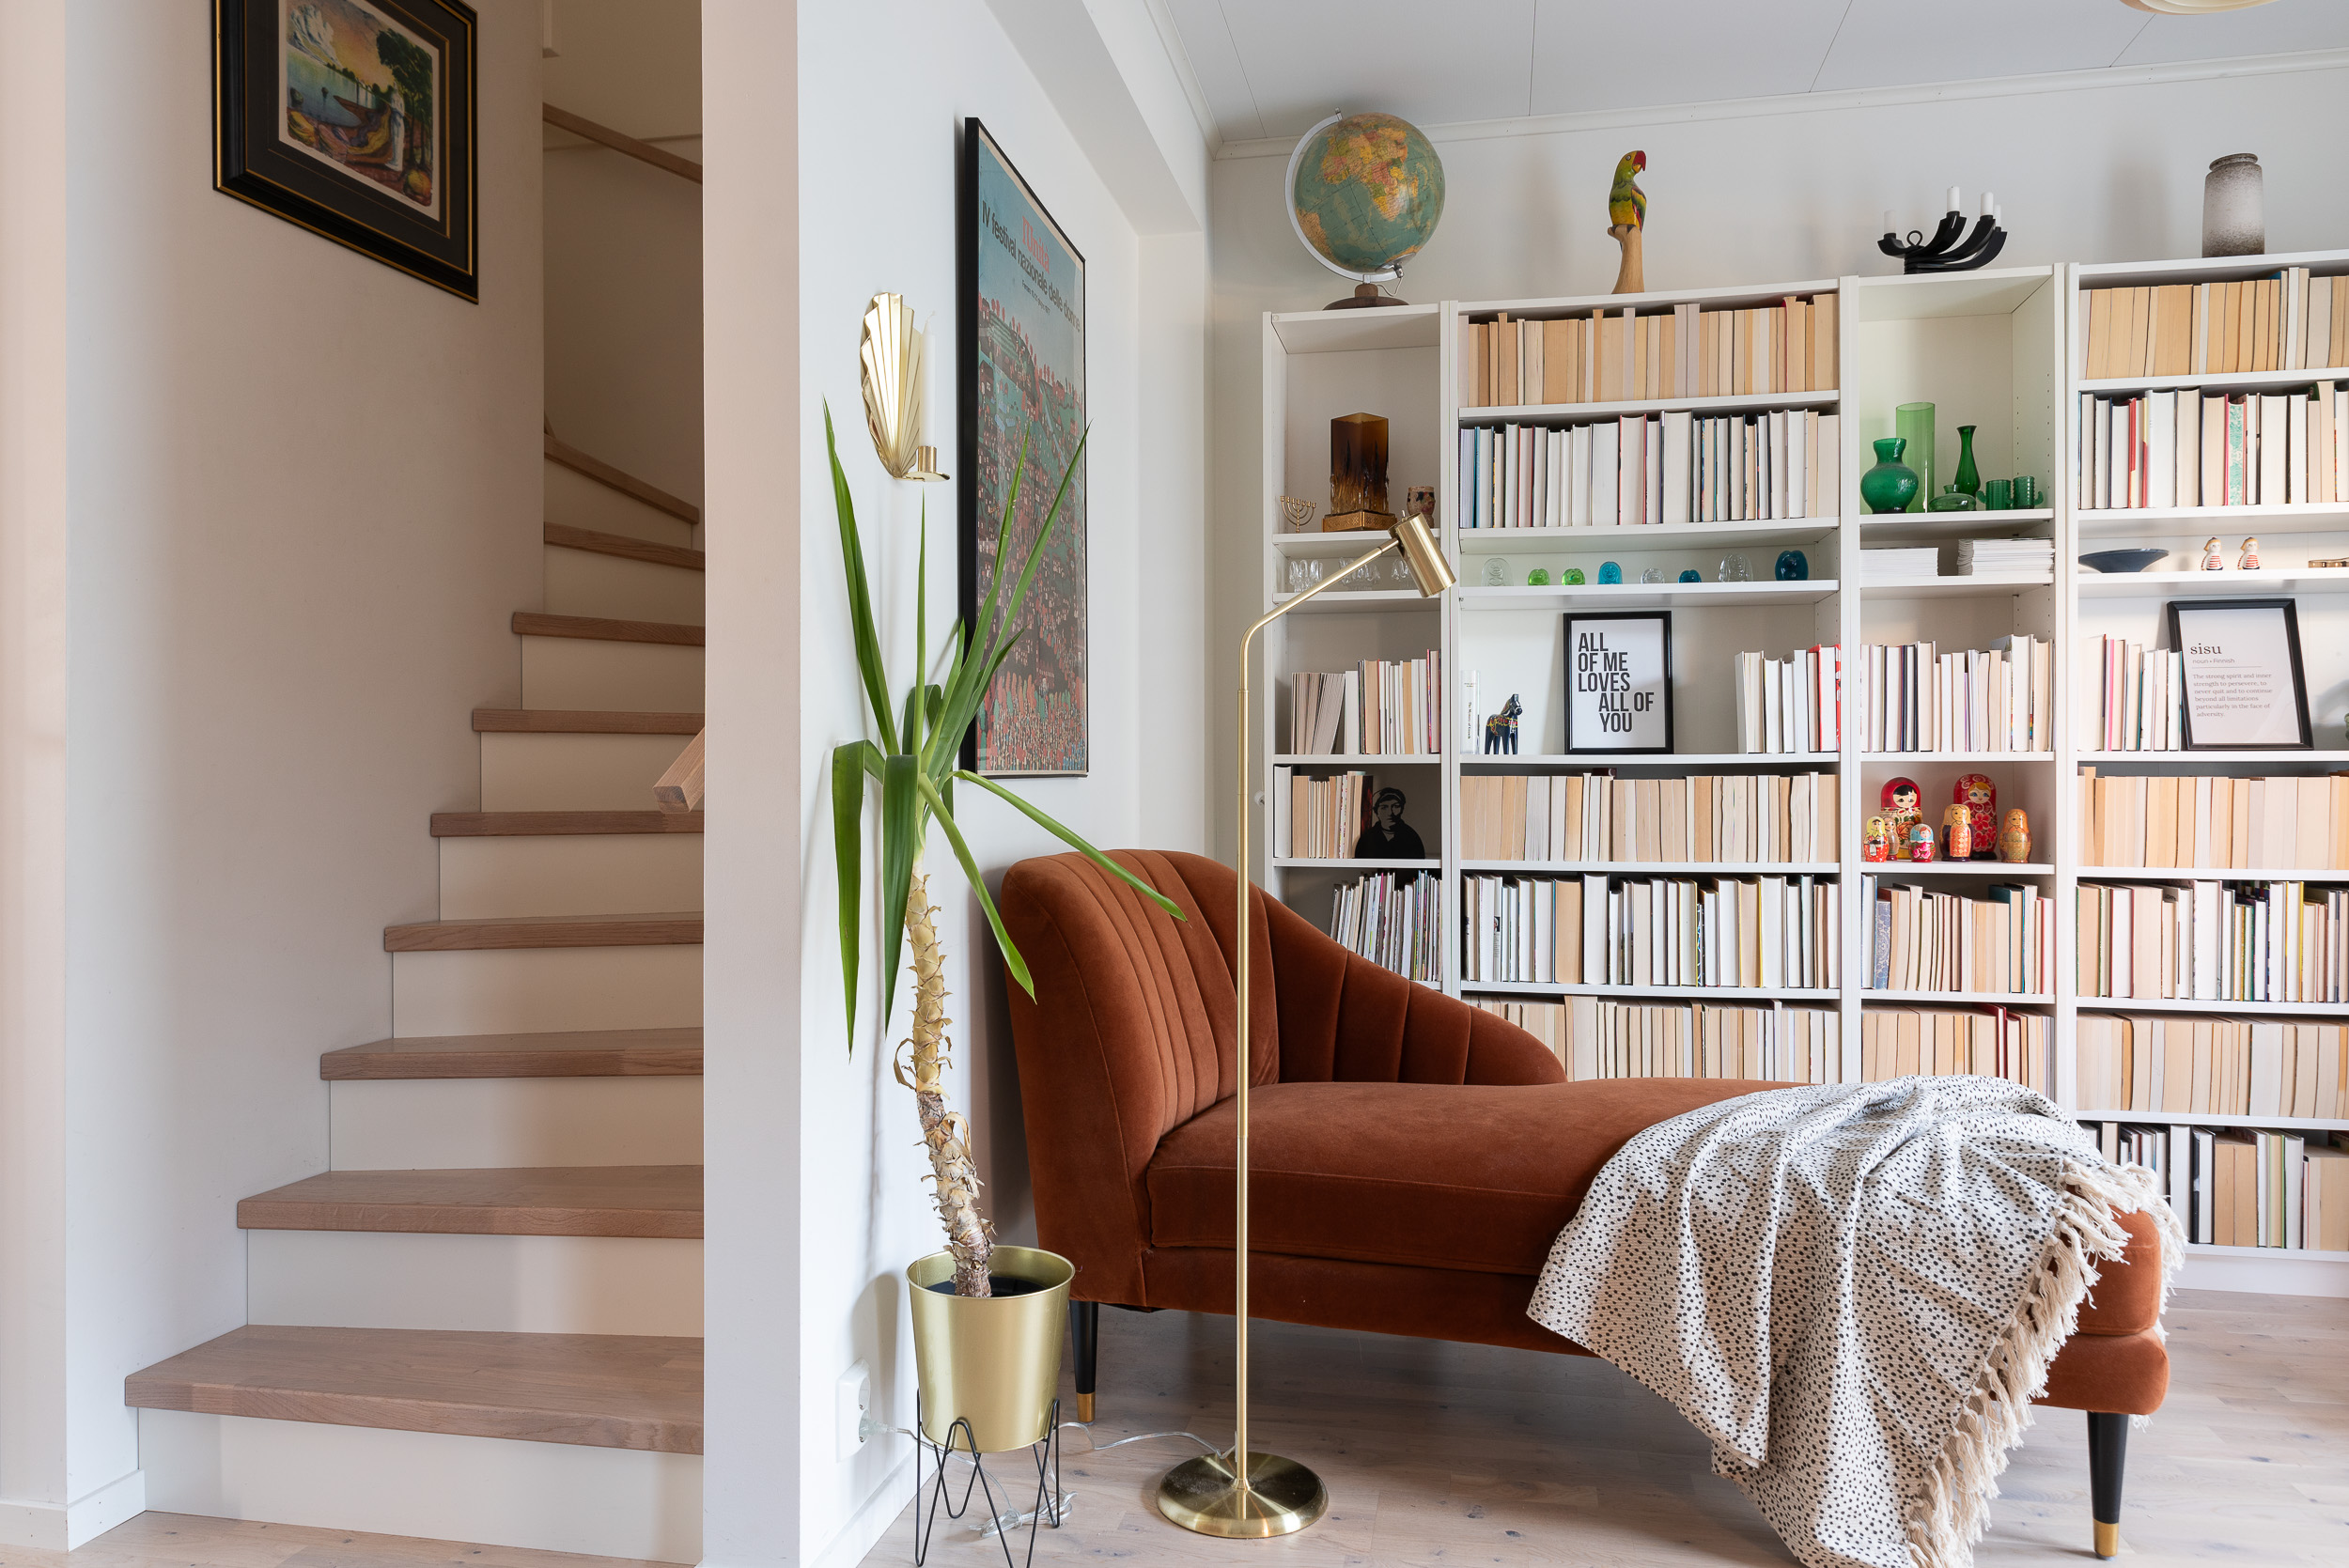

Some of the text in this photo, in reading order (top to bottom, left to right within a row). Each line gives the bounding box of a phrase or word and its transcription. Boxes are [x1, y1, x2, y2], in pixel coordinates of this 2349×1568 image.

[982, 199, 990, 228] IV
[991, 212, 1017, 260] festival
[1018, 248, 1049, 295] nazionale
[1049, 282, 1064, 312] delle
[1064, 299, 1081, 333] donne
[1579, 632, 1609, 652] ALL
[2190, 643, 2222, 655] sisu
[1579, 652, 1628, 672] OF ME
[1579, 672, 1630, 692] LOVES
[1598, 691, 1655, 712] ALL OF
[2195, 703, 2231, 711] particularly
[1599, 712, 1633, 733] YOU
